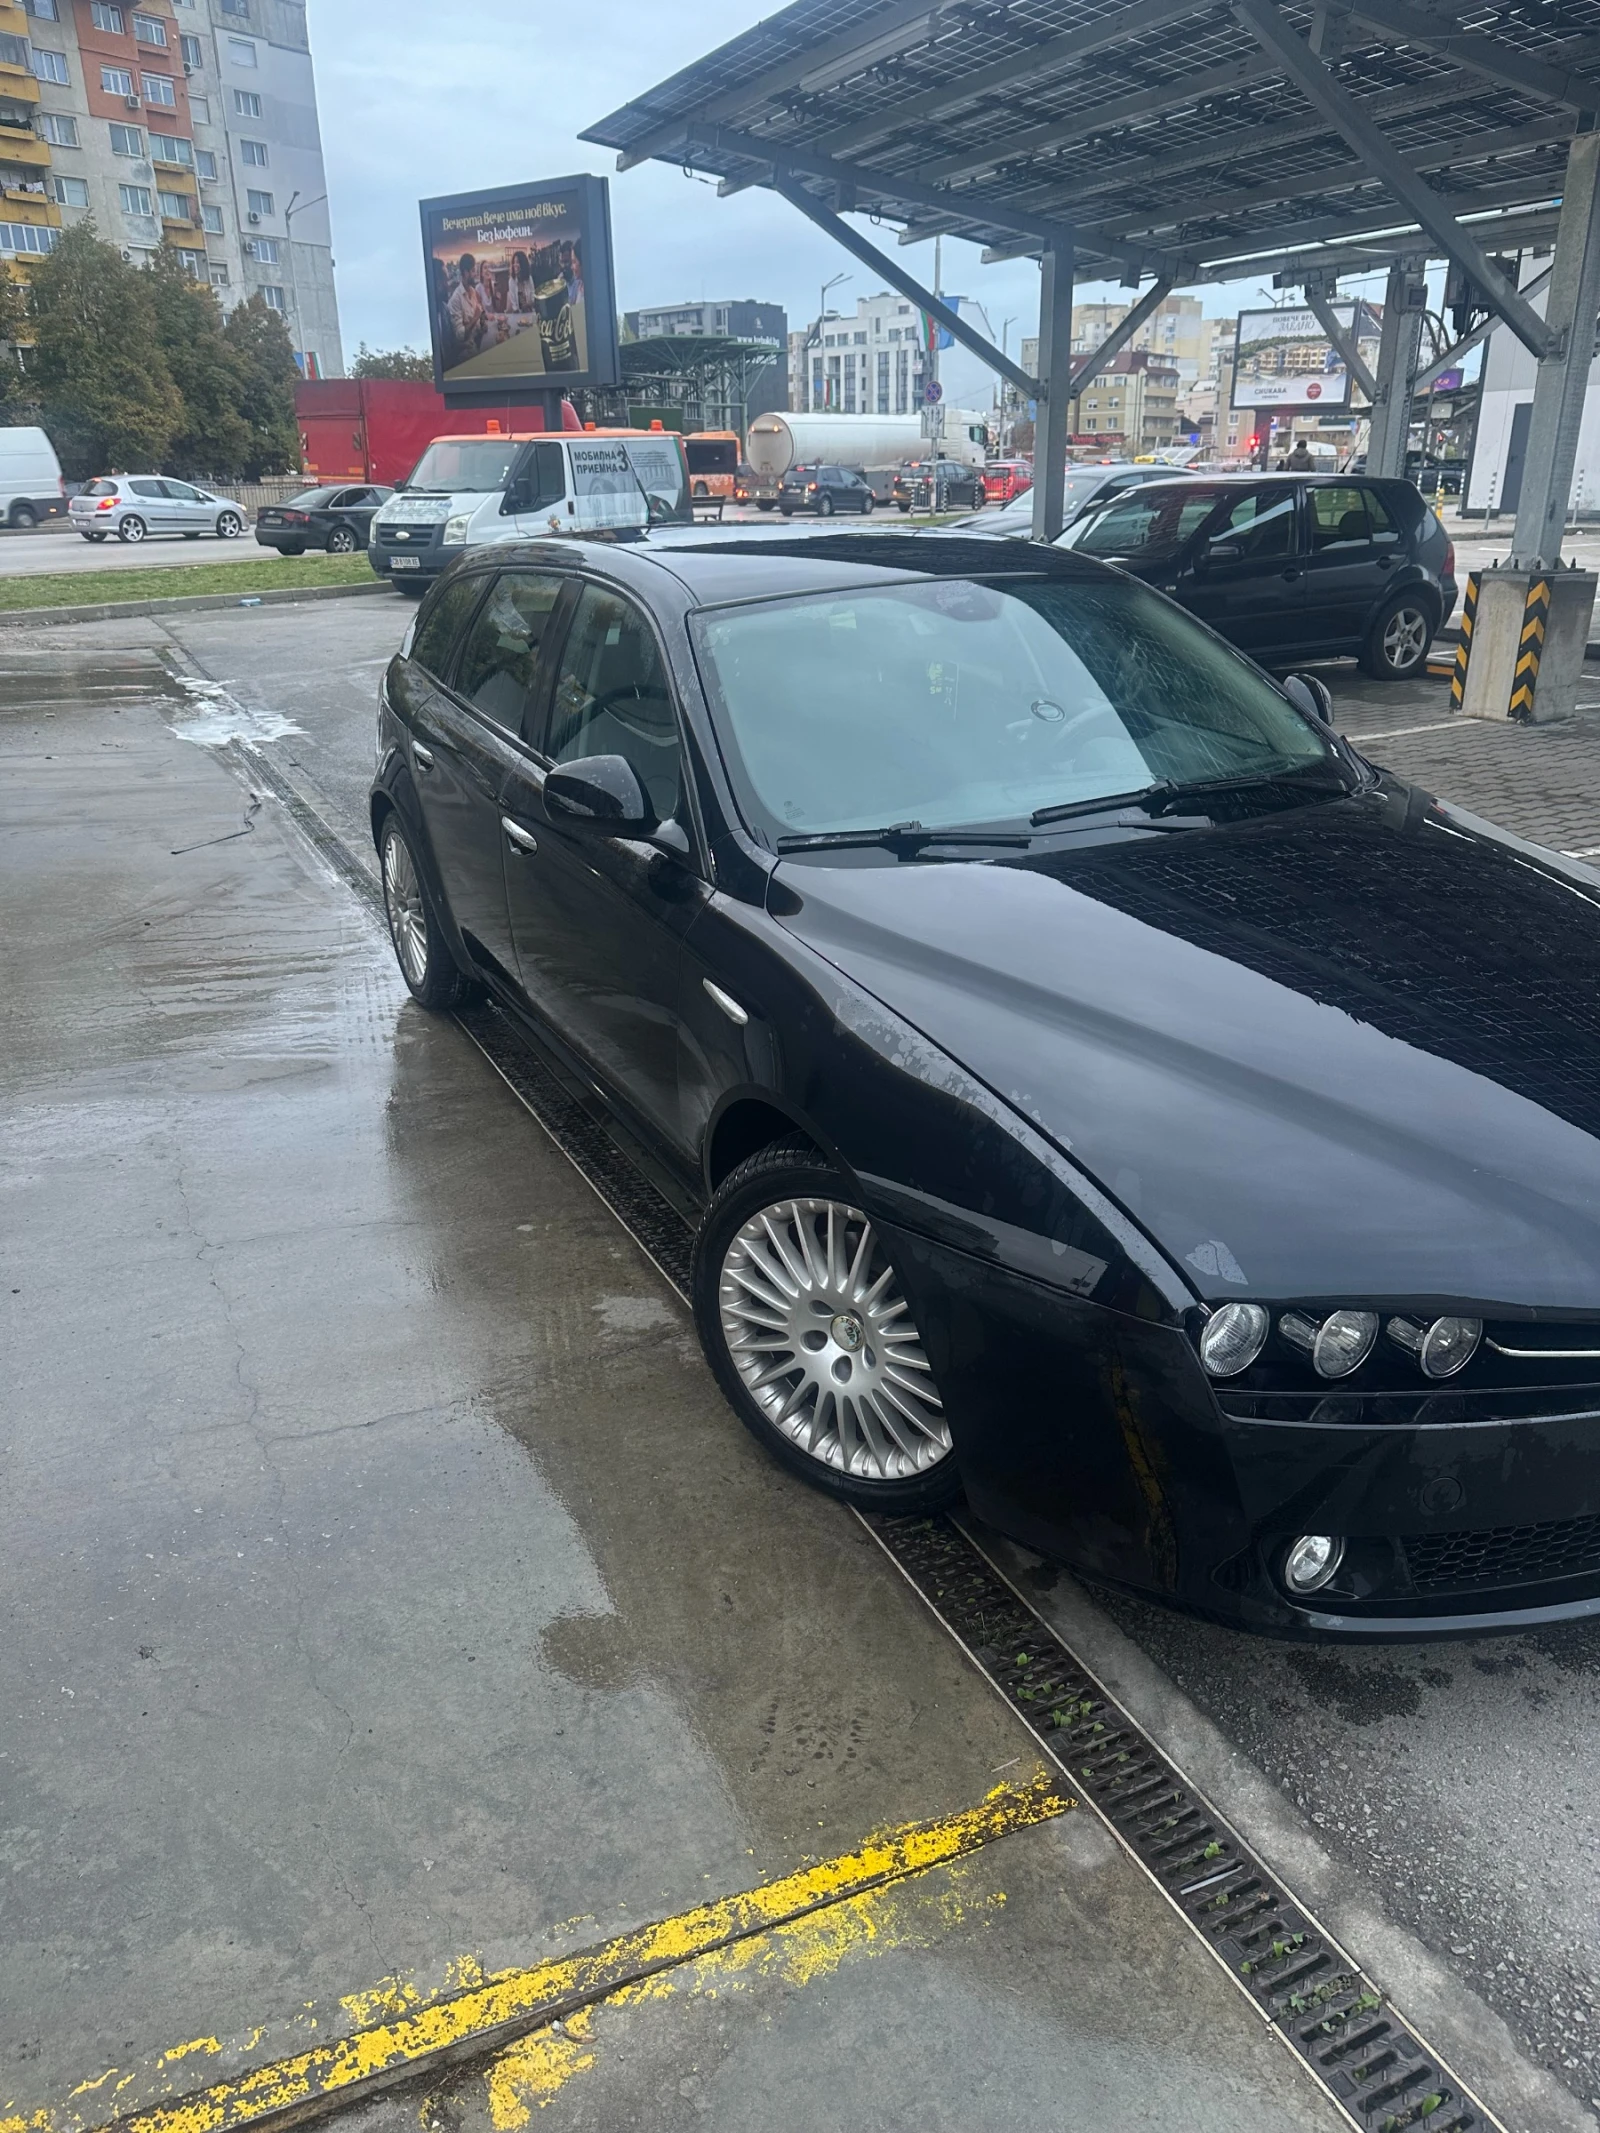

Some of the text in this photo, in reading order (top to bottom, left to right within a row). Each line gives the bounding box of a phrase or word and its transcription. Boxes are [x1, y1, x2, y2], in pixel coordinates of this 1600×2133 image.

[442, 215, 484, 231] Вечерта
[506, 209, 524, 221] има
[525, 203, 542, 219] нов
[477, 229, 493, 244] Без
[1273, 315, 1300, 323] ПОВЕЧЕ
[574, 451, 617, 461] МОБИЛНА
[617, 450, 629, 472] 3
[576, 463, 618, 474] ПРИЕМНА
